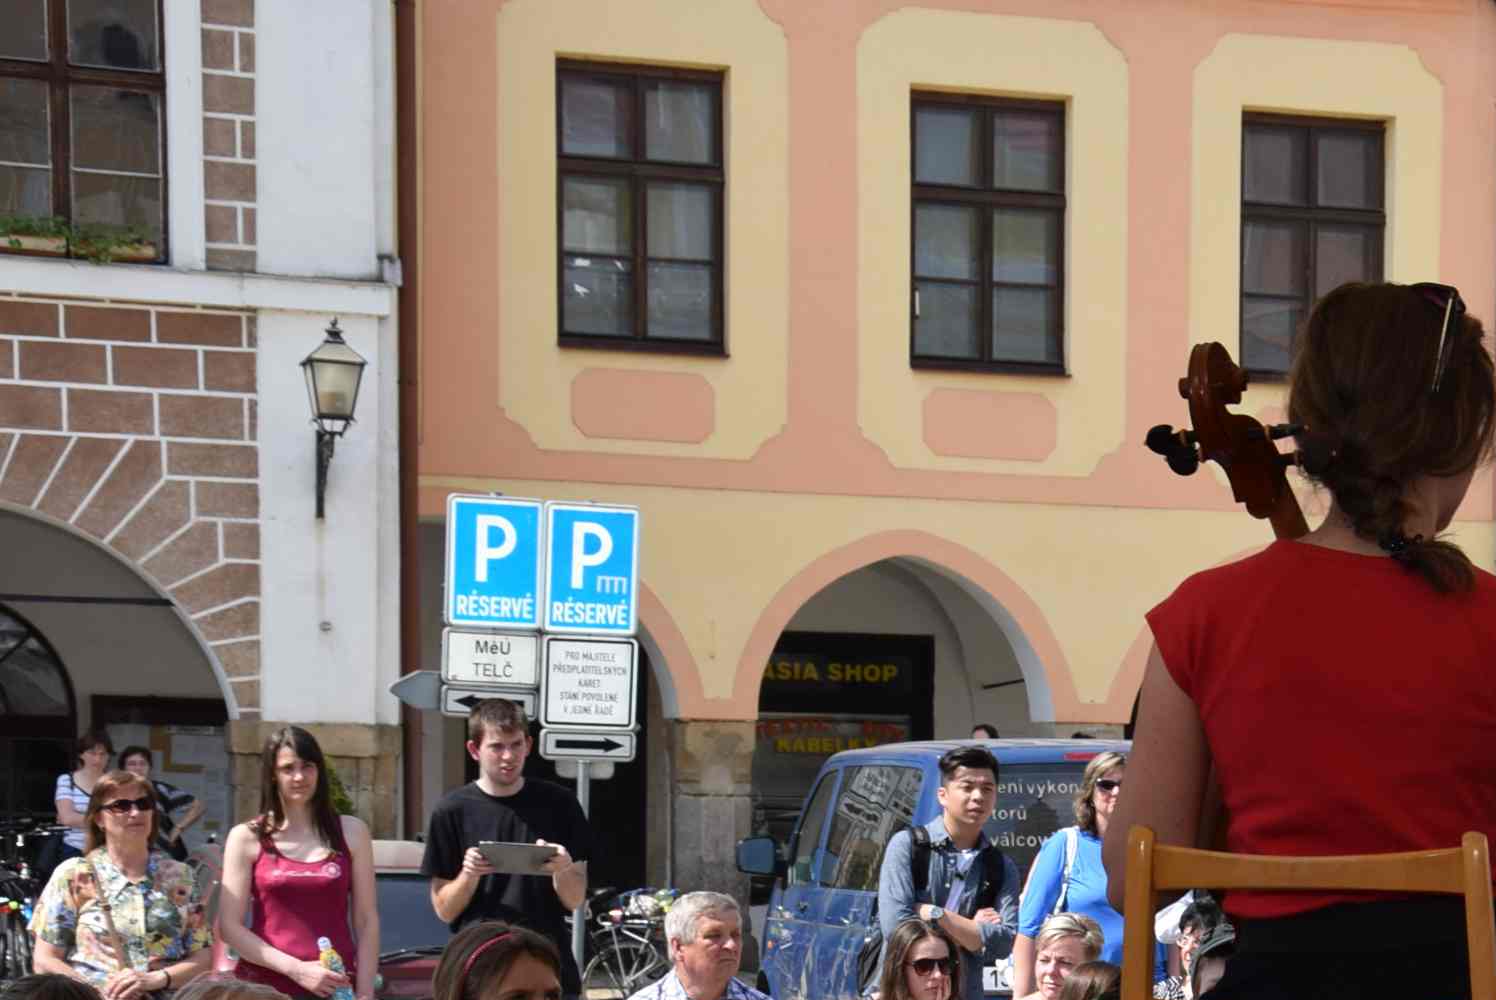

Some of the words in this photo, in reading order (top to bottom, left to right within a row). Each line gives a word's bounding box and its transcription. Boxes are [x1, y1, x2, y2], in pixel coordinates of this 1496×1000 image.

[475, 514, 517, 582] P
[571, 521, 613, 589] P
[456, 590, 534, 619] RÉSERVÉ
[552, 596, 628, 625] RÉSERVÉ
[472, 662, 514, 679] TELČ
[764, 661, 819, 681] ASIA
[827, 663, 898, 683] SHOP
[991, 804, 1027, 820] torů
[990, 831, 1047, 847] válcov
